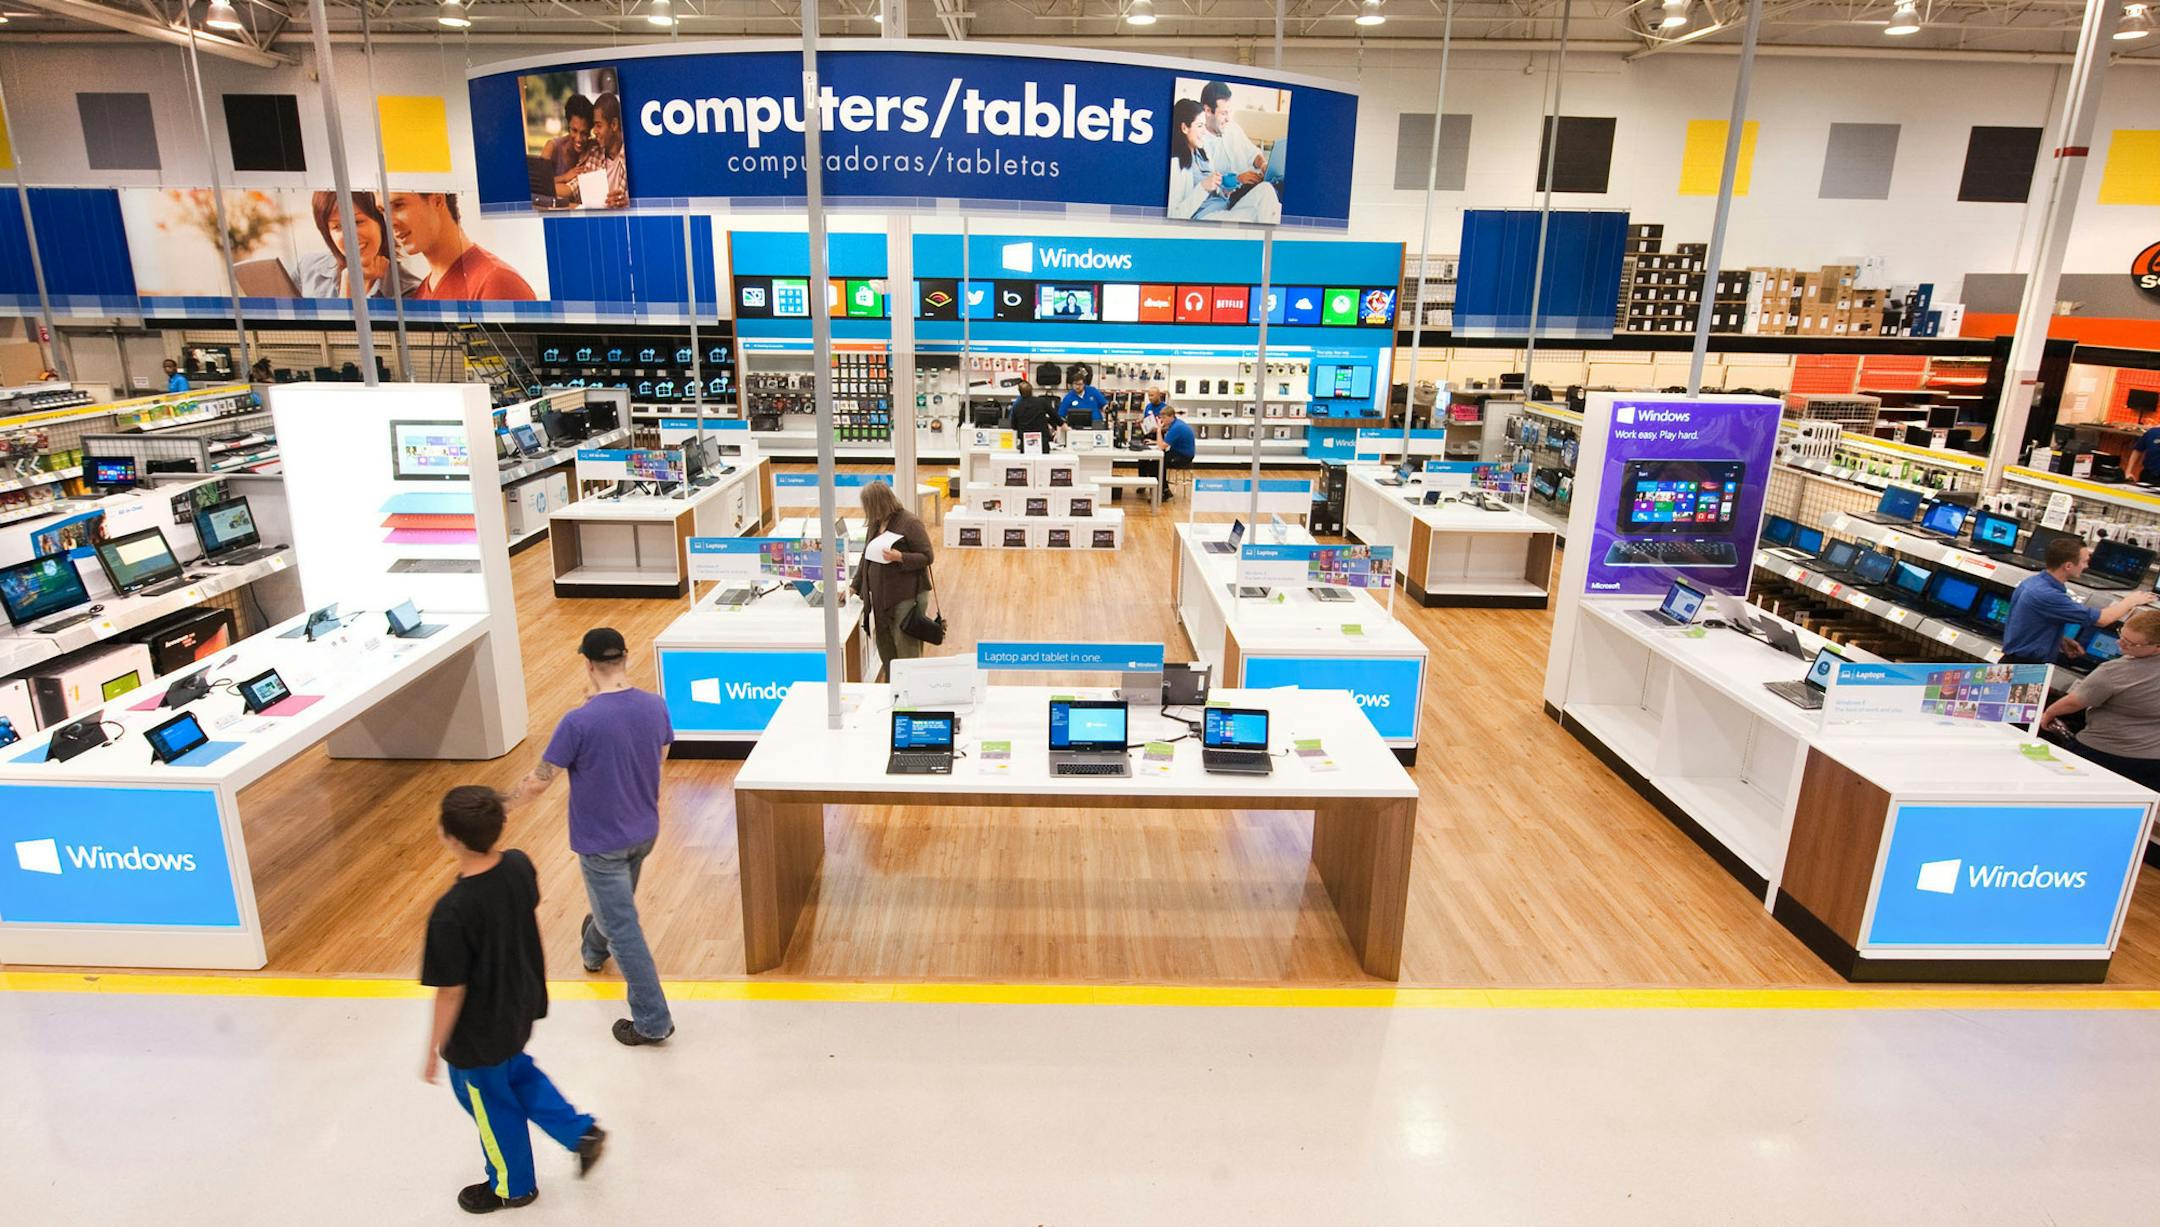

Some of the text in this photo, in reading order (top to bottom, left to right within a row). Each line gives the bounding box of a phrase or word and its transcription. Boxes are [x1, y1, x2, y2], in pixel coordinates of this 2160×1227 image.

[641, 78, 1153, 148] computers/tablets
[1039, 248, 1133, 270] Windows
[1637, 409, 1691, 422] Windows
[1615, 430, 1699, 442] Work easy. Play hard.
[984, 652, 1103, 663] Laptop and tablet in one.
[1856, 671, 1886, 680] Laptops
[725, 681, 791, 700] Windo
[66, 845, 196, 872] Windows
[1969, 864, 2088, 889] Windows
